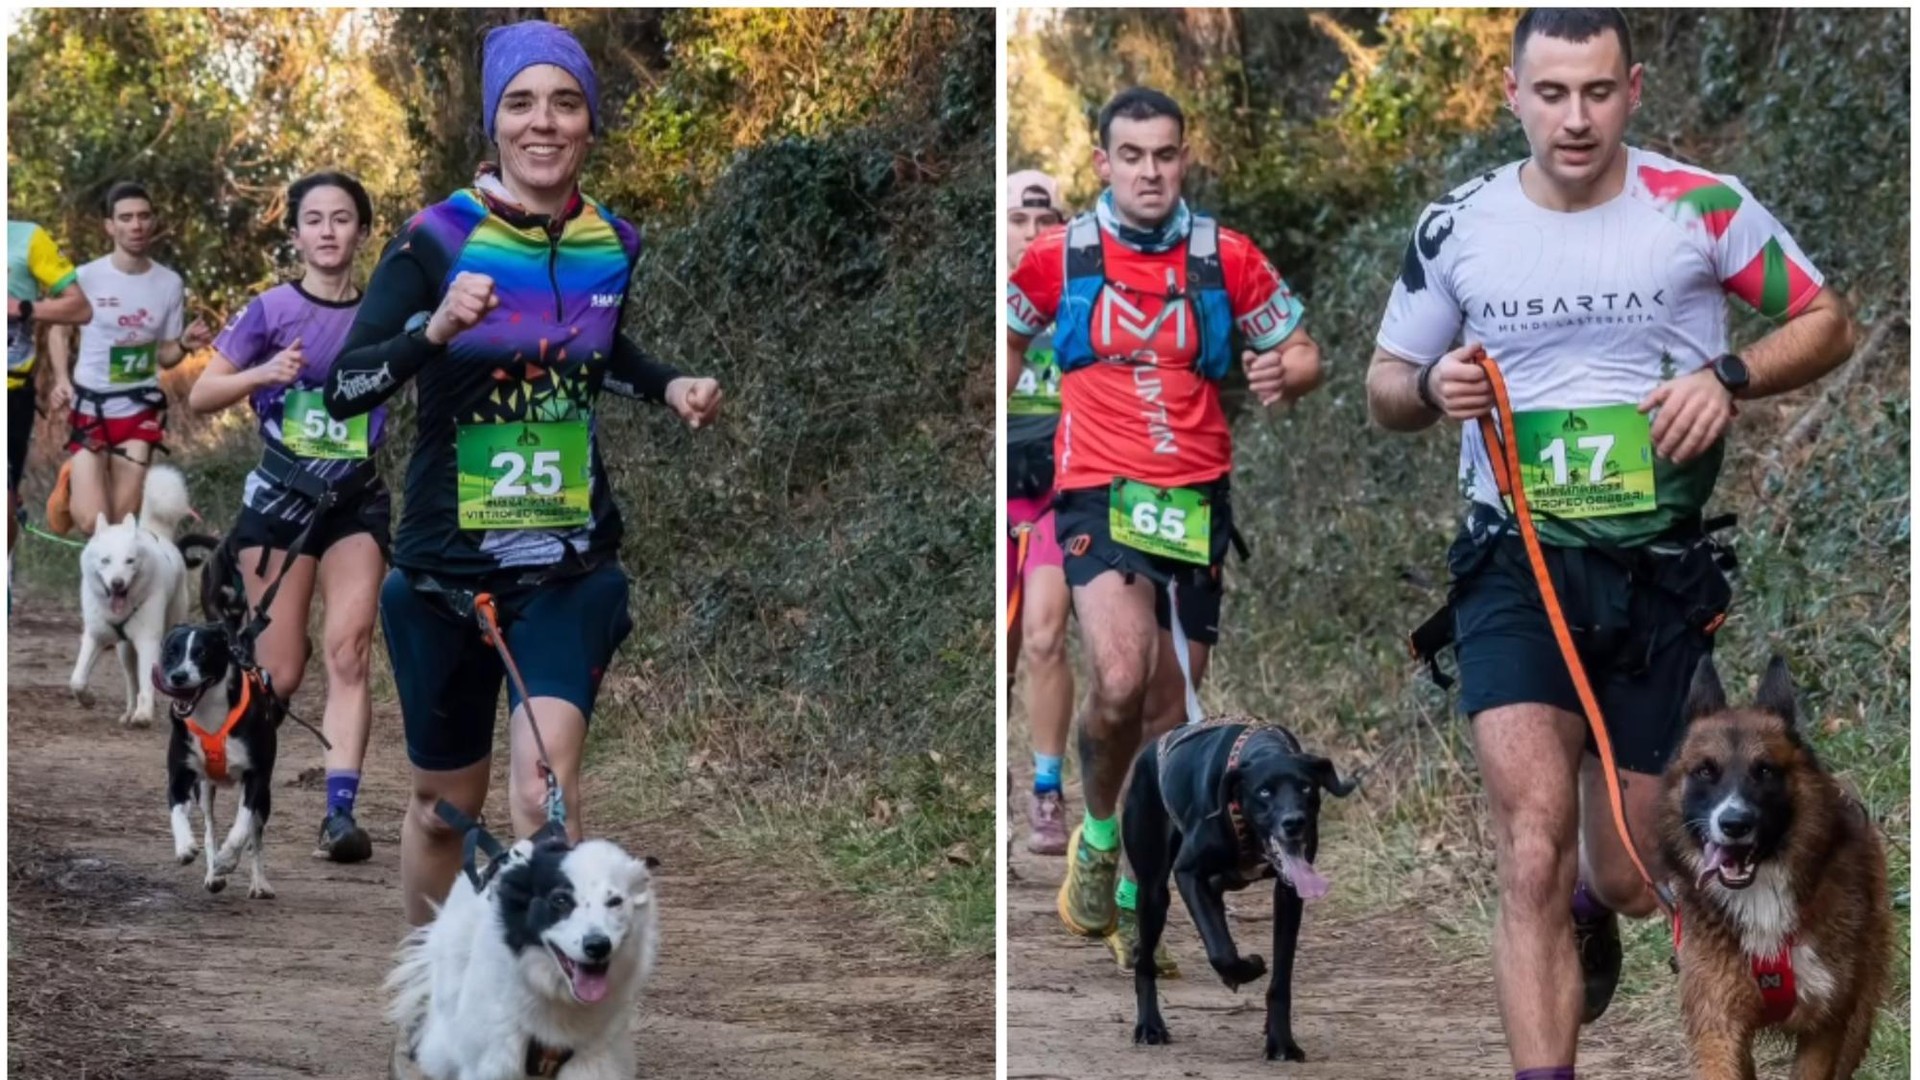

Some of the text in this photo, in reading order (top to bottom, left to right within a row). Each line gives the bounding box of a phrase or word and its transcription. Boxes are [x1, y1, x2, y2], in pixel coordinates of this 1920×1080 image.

[122, 352, 149, 373] 74
[304, 409, 348, 443] 56
[491, 450, 563, 497] 25
[1540, 434, 1615, 485] 17
[1132, 501, 1186, 541] 65
